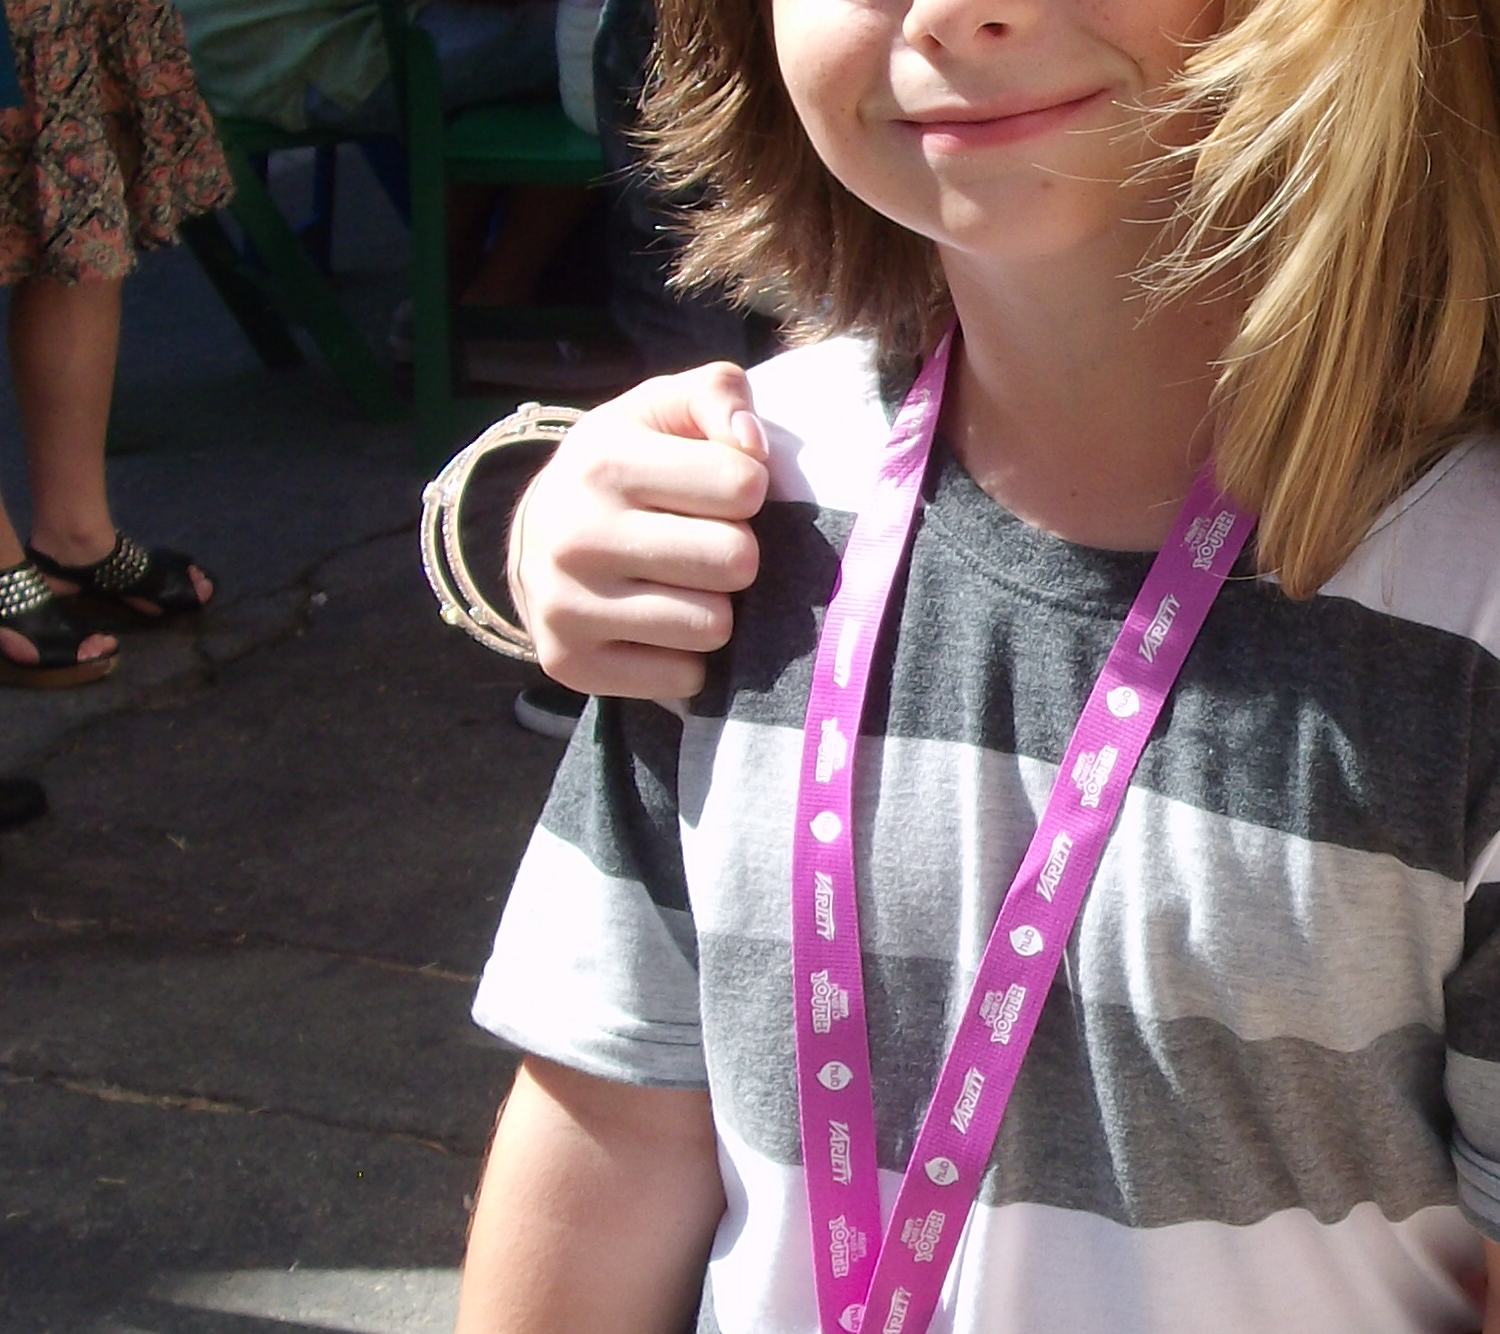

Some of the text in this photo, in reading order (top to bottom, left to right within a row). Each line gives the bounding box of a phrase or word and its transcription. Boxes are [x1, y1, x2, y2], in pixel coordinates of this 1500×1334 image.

[1193, 510, 1235, 570] YOUTH
[1138, 593, 1181, 664] VARIETY
[1036, 829, 1074, 903] VARIETY
[814, 870, 836, 942] VARIETY
[1017, 928, 1035, 952] hub
[810, 969, 833, 1035] YOUTH
[990, 983, 1026, 1045] YOUTH
[829, 1065, 841, 1088] hub
[950, 1067, 986, 1135] VARIETY
[828, 1118, 854, 1187] VARIETY
[934, 1159, 950, 1183] hub
[828, 1214, 849, 1279] YOUTH
[913, 1210, 946, 1263] YOUTH
